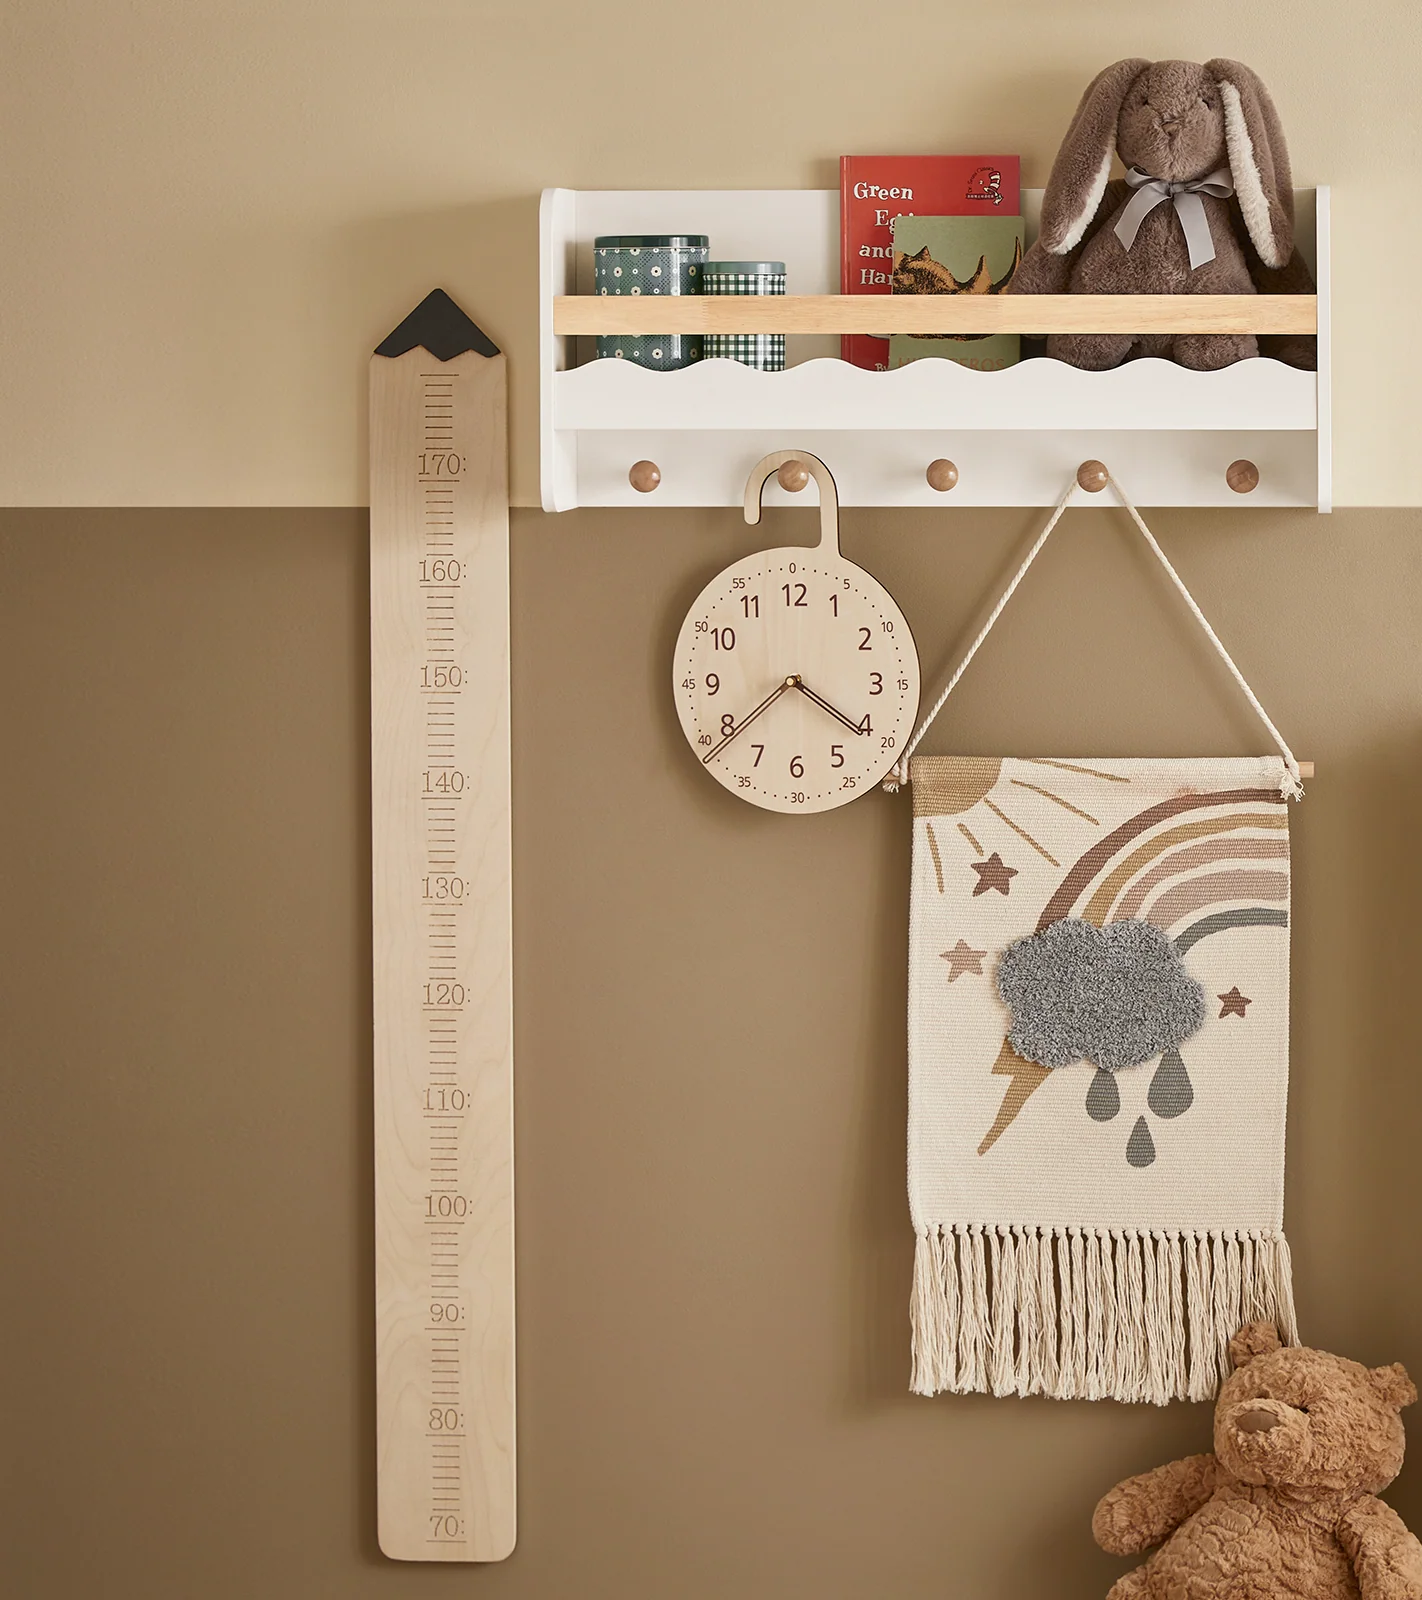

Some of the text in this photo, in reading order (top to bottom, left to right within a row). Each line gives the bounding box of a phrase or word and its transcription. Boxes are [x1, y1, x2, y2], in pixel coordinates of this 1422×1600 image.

[853, 181, 914, 200] Green
[788, 562, 797, 574] 0
[732, 577, 746, 589] 55
[843, 578, 851, 590] 5
[781, 583, 808, 607] 12
[740, 594, 760, 618] 11
[828, 593, 838, 617] 1
[694, 621, 709, 633] 50
[881, 621, 894, 633] 10
[709, 626, 736, 651] 10
[858, 626, 873, 651] 2
[681, 678, 696, 690] 45
[705, 672, 721, 697] 9
[868, 671, 884, 696] 3
[897, 679, 909, 691] 15
[720, 713, 736, 737] 8
[858, 713, 874, 737] 4
[697, 734, 712, 747] 40
[880, 736, 896, 749] 20
[750, 744, 765, 768] 7
[830, 744, 845, 768] 5
[789, 755, 805, 779] 6
[737, 776, 752, 788] 35
[842, 777, 857, 789] 25
[790, 791, 805, 804] 30
